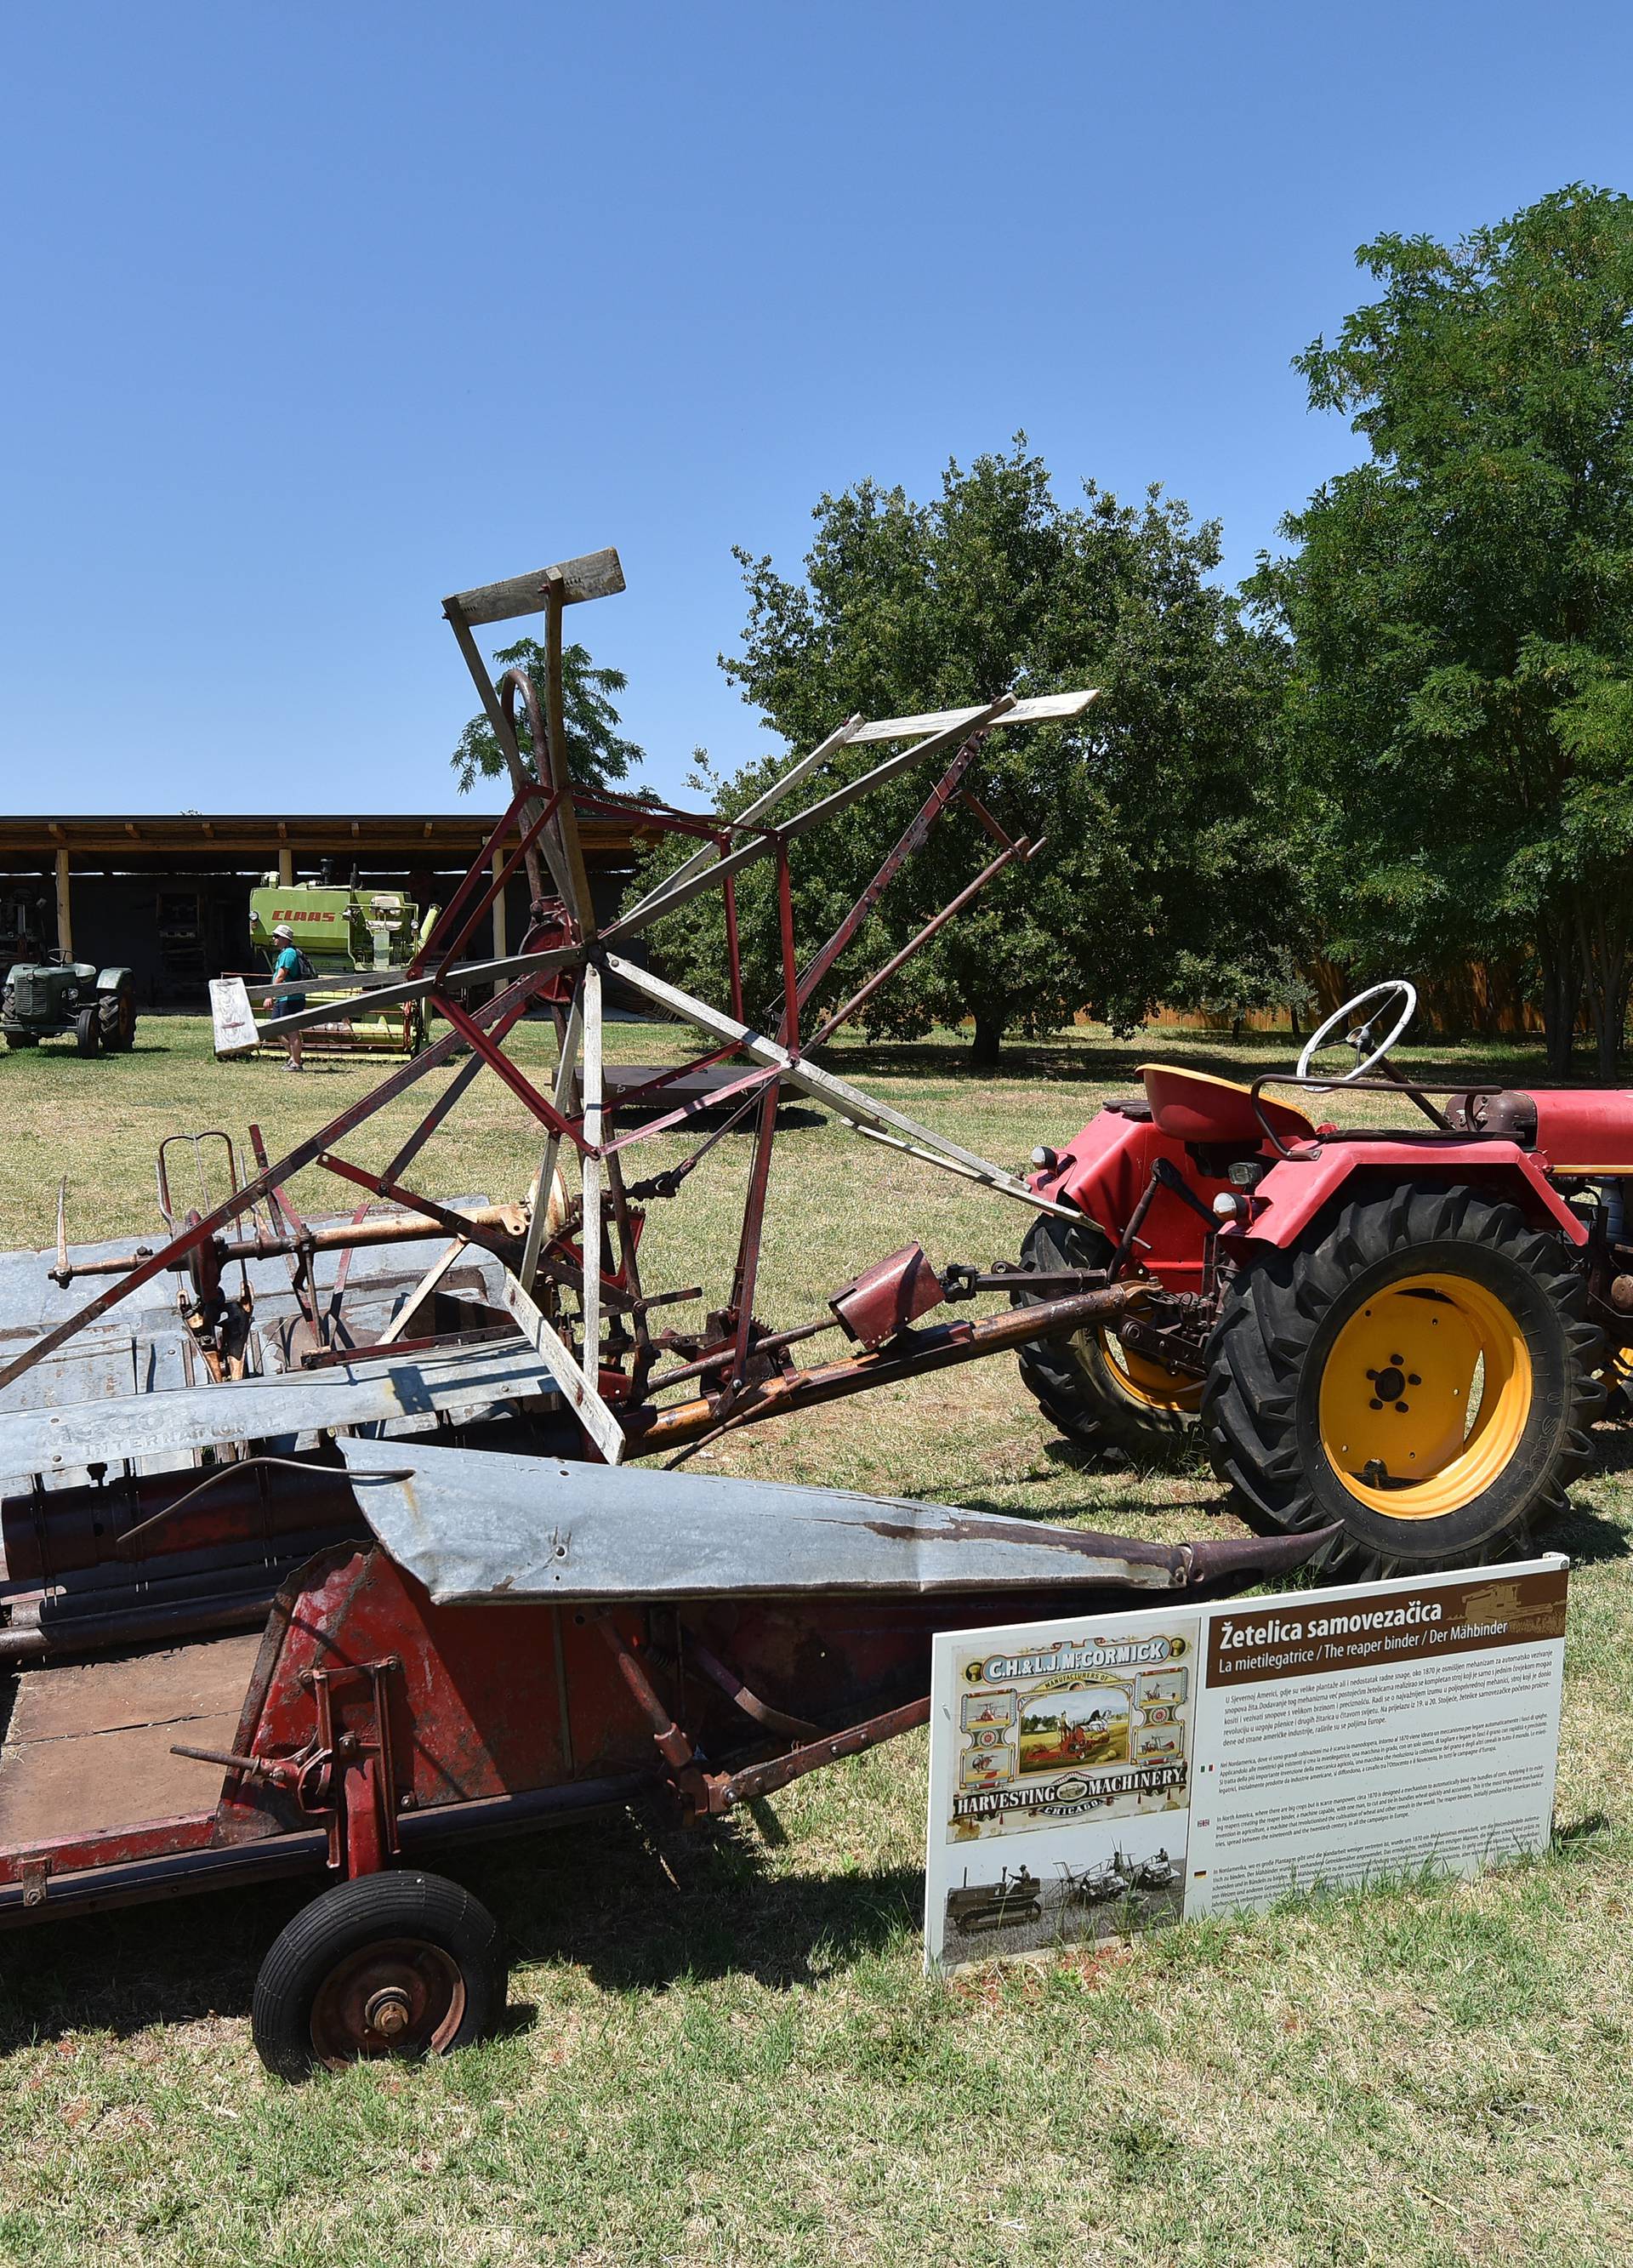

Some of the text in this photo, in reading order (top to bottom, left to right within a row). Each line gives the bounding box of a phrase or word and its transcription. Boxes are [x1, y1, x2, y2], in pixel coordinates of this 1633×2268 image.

[272, 910, 336, 922] CLAAS
[1219, 1600, 1442, 1650] Žetelica samovezačica
[1219, 1658, 1232, 1673] La
[1235, 1648, 1314, 1672] mietilegatrice
[1323, 1642, 1344, 1659] The
[1346, 1640, 1382, 1658] reaper
[1384, 1633, 1420, 1650] binder
[1430, 1629, 1448, 1644] Der
[1450, 1620, 1508, 1641] Mähbinder
[1044, 1672, 1109, 1689] MANUFACTURERS OF
[958, 1768, 1184, 1815] HARVESTING MACHINERY.
